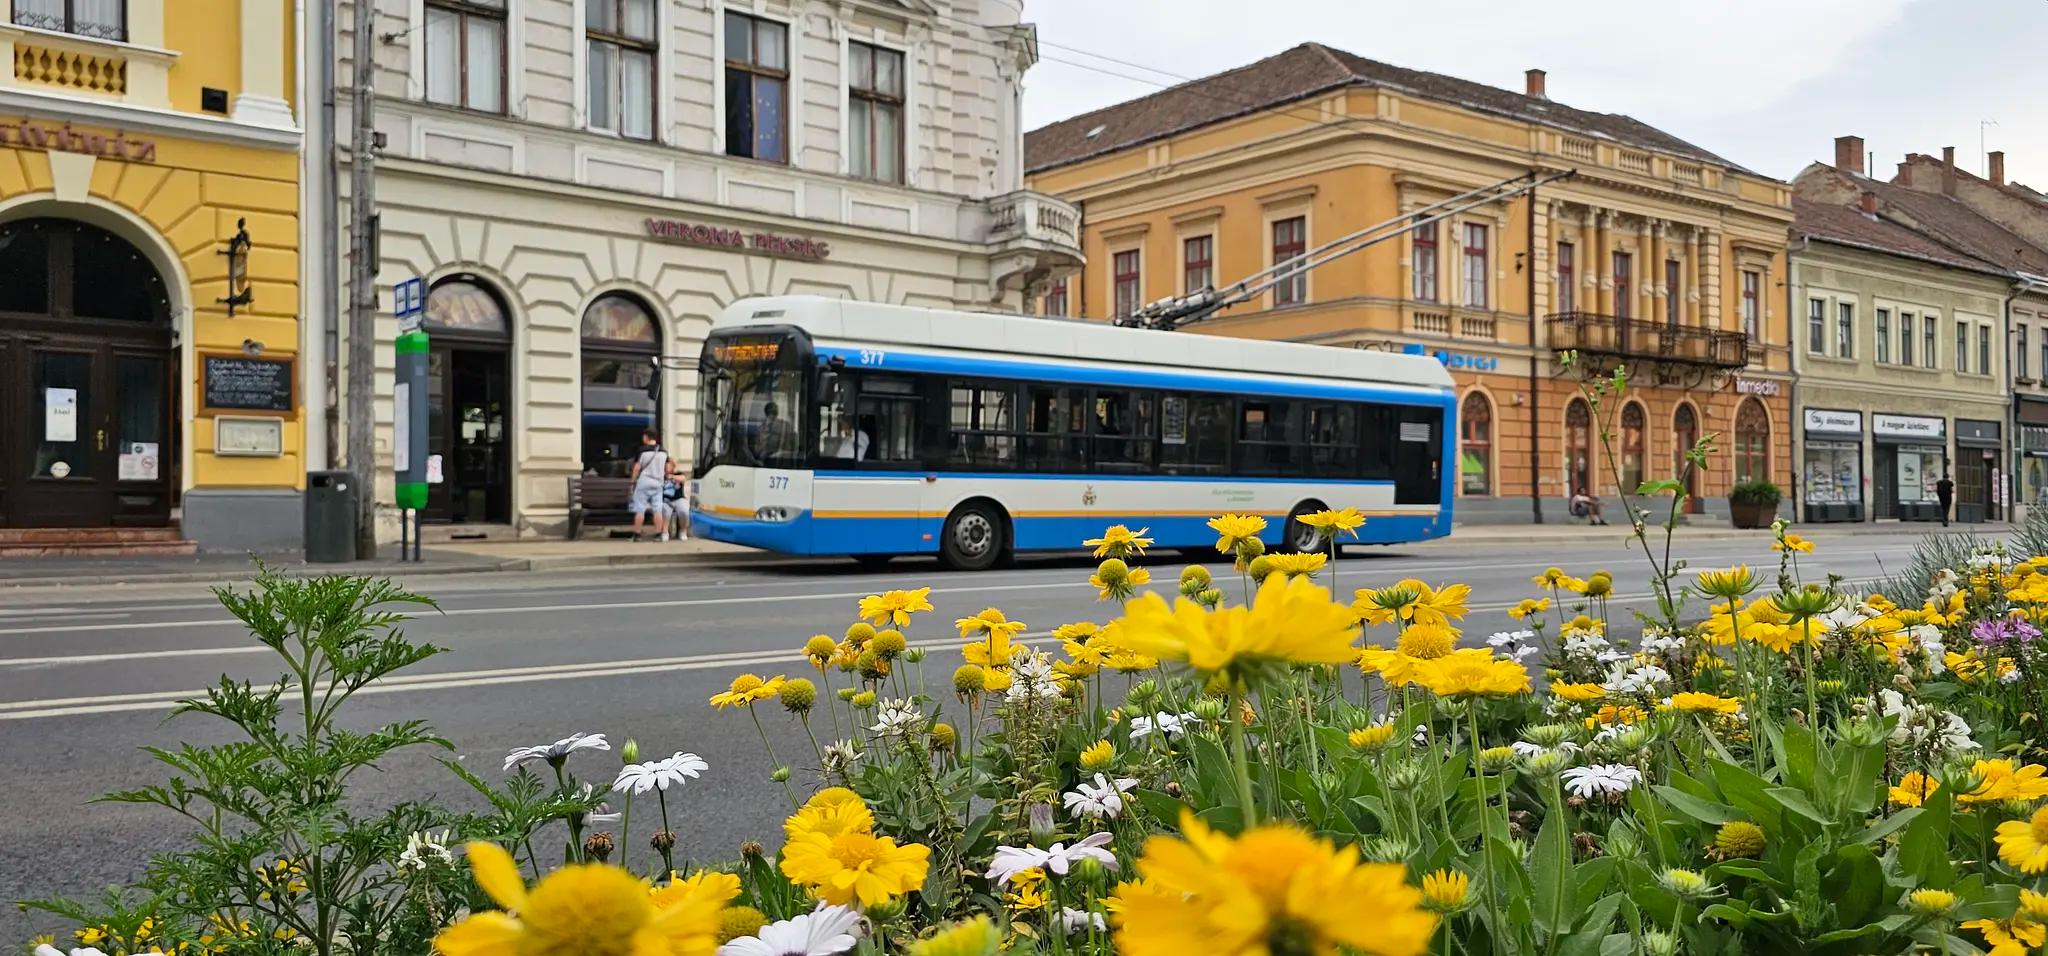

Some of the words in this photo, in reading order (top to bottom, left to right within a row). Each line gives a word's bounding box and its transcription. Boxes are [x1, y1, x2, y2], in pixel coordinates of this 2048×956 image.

[645, 217, 745, 248] VERONA
[860, 349, 885, 366] 377
[1451, 353, 1497, 371] DIGI
[1736, 376, 1779, 396] inmedio
[769, 476, 789, 490] 377
